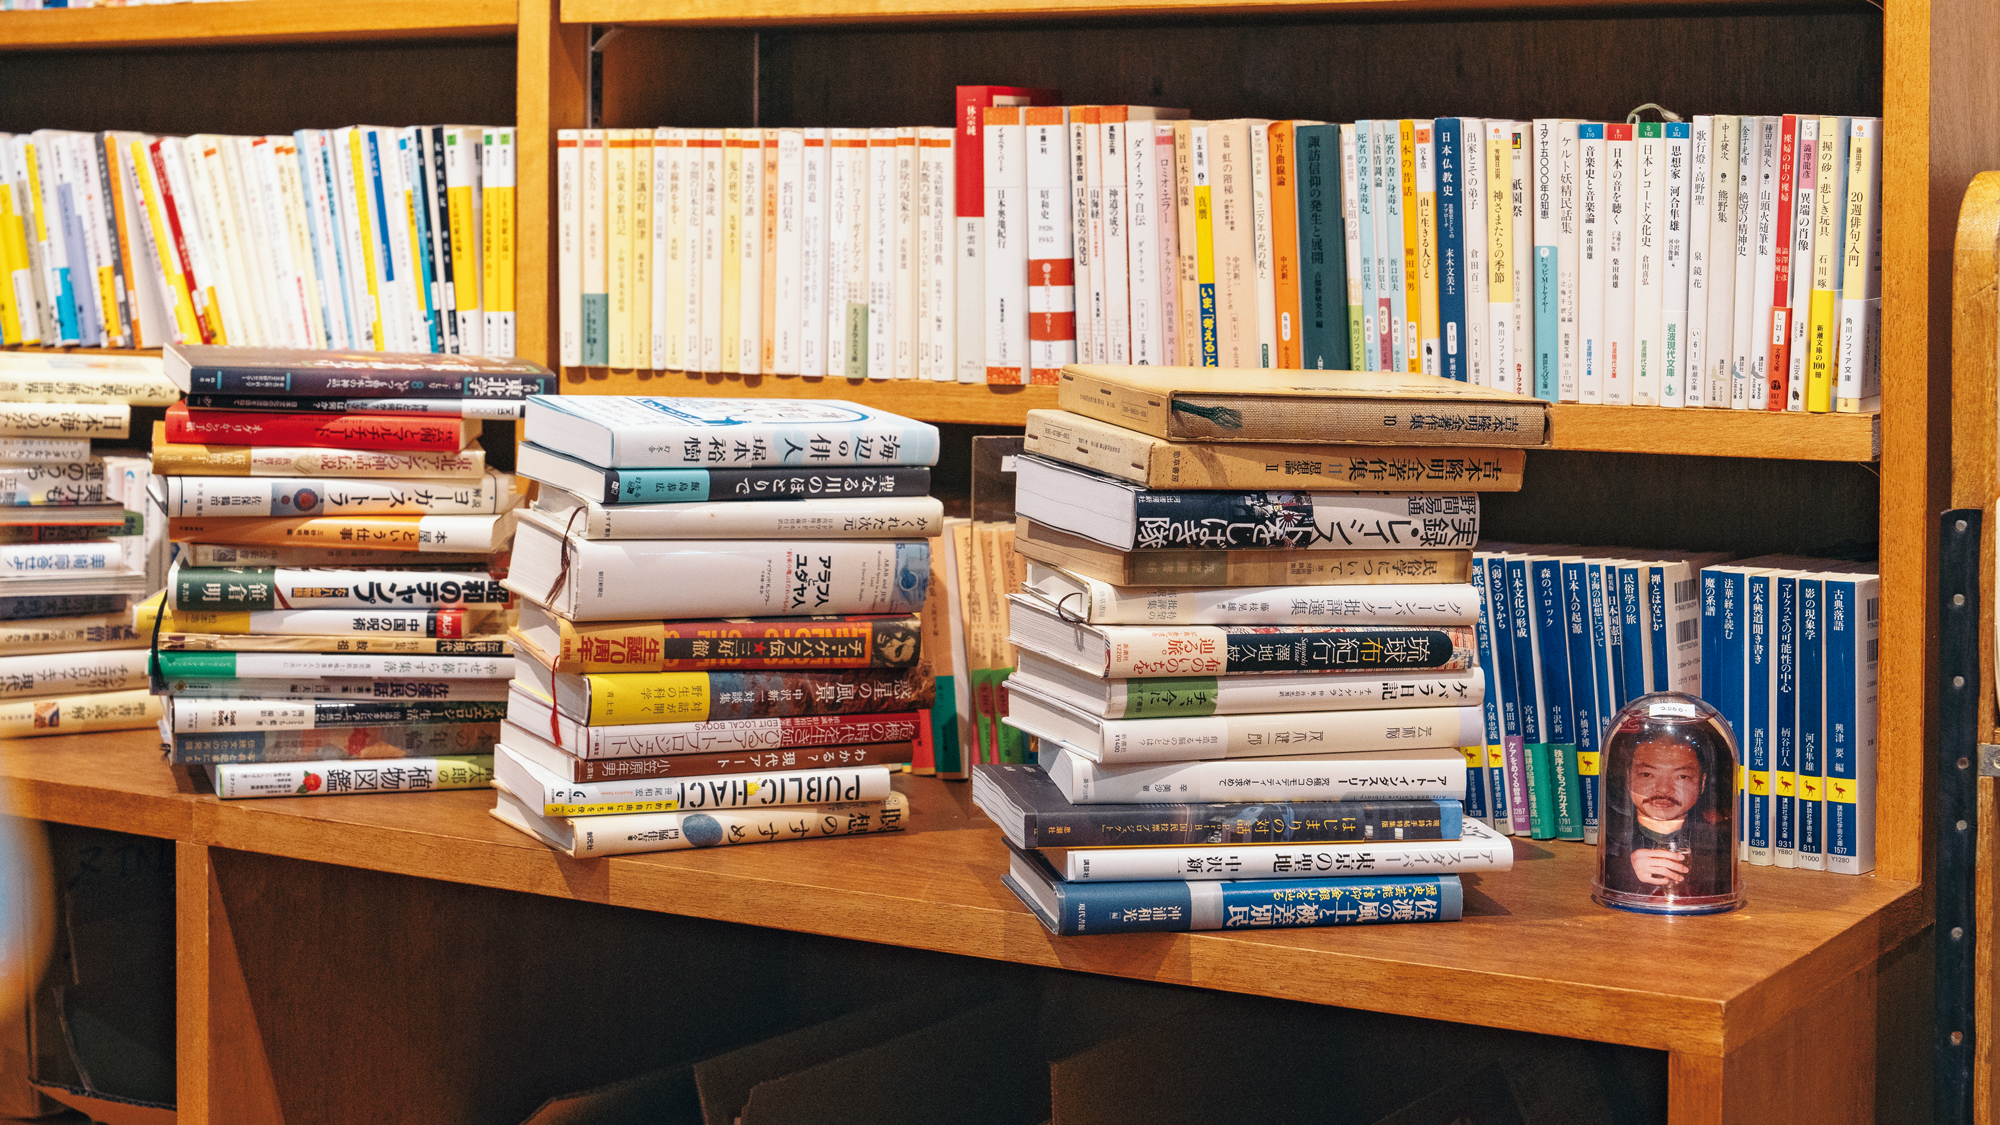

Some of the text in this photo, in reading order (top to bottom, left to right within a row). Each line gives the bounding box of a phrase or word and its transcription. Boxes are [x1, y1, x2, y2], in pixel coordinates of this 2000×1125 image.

[1196, 136, 1204, 166] 吉本隆明
[1720, 123, 1730, 161] 中上健次
[1741, 125, 1750, 166] 金子光晴
[1763, 124, 1773, 168] 種田山頭火
[1178, 134, 1189, 207] 対話 日本の原像
[1221, 153, 1233, 200] 虹の階梯
[1275, 133, 1286, 187] 雪片曲線論
[1357, 133, 1370, 215] 死者の書・身毒丸
[1385, 133, 1398, 216] 死者の書・身毒丸
[1401, 131, 1413, 197] 日本の昔話
[1419, 147, 1427, 173] 宮本常一
[1442, 131, 1453, 197] 日本仏教史
[1467, 131, 1479, 210] 出家とその弟子
[1694, 130, 1706, 206] 歌行燈・高野聖
[1780, 133, 1792, 202] 裸婦の中の裸婦
[729, 161, 739, 203] 鬼の研究
[808, 160, 817, 203] 仮面の道
[900, 159, 910, 224] 排除の現象学
[1134, 138, 1145, 226] ダライ・ラマ自伝
[1160, 158, 1171, 224] ロミオ・エラー
[1560, 136, 1572, 234] ケルト妖精民話集
[1611, 147, 1623, 225] 日本の音を聴く
[1641, 144, 1652, 247] 日本レコード文化史
[1669, 145, 1682, 232] 思想家 河合隼雄
[1819, 133, 1833, 237] 一握の砂・悲しき玩具
[783, 181, 793, 233] 折口信夫
[933, 161, 943, 266] 英語類義語活用辞典
[1040, 190, 1050, 220] 昭和史
[1109, 189, 1119, 237] 神道の成立
[1308, 134, 1324, 264] 諏訪信仰の発生と展開
[1584, 145, 1596, 261] 音楽史と音楽論 柴田南雄
[1717, 189, 1728, 223] 熊野集
[998, 190, 1007, 249] 日本奥地紀行
[1076, 188, 1088, 266] 日本音楽の再発見
[1347, 198, 1358, 240] 先祖の話
[1737, 191, 1749, 257] 絶望の精神史
[1758, 190, 1771, 256] 山頭火随筆集
[1797, 192, 1811, 252] 異端の肖像
[967, 222, 976, 258] 狂雲集
[1256, 203, 1267, 280] 三万年の死の教え
[1420, 197, 1431, 279] 山に生きる人びと
[1493, 190, 1505, 284] 神さまたちの季節
[1363, 257, 1372, 291] 折口信夫
[1390, 258, 1399, 292] 折口信夫
[1405, 248, 1415, 292] 柳田国男
[1446, 248, 1455, 295] 末木文美士
[1471, 248, 1480, 293] 倉田百三
[1692, 251, 1702, 288] 泉鏡花
[1666, 323, 1676, 378] 岩波現代文庫
[1812, 324, 1825, 379] 新潮文庫の100冊
[1843, 317, 1853, 382] 角川ソフィア文庫
[468, 377, 523, 396] 東北学
[185, 421, 452, 442] 芸術とマルチチュード ネグリからの手紙
[1410, 413, 1518, 432] 吉本隆明全著作集
[320, 454, 472, 471] 東北アジアの神話・伝説
[683, 433, 901, 464] 海辺の俳人 堀本裕樹
[28, 462, 104, 482] 運のうち
[736, 475, 895, 495] 聖なる川のほとりで
[1285, 456, 1502, 482] 吉本隆明全著作集 11 思想論
[46, 483, 104, 502] 実力も
[210, 496, 262, 506] 佐保田鶴治
[328, 490, 470, 508] ヨーガ・スートラ
[472, 488, 482, 508] 解説
[655, 481, 700, 493] 飯島恭広
[1408, 495, 1476, 517] 野間易通
[339, 528, 448, 544] 本屋という仕事
[843, 516, 928, 532] かくれた次元
[1138, 516, 1477, 549] 実録・レイシストをしばき隊
[791, 554, 808, 610] ユダヤ人
[807, 578, 819, 587] と
[814, 555, 832, 609] アラブ人
[1330, 558, 1437, 577] 民俗学について
[199, 582, 223, 602] 明
[227, 582, 267, 603] 笹倉
[1148, 599, 1178, 609] 批評集
[1227, 598, 1463, 616] グリーンバーグ批評選集 藤枝晃雄
[1512, 568, 1528, 638] 日本文化の形成
[1540, 568, 1554, 628] 森のバロック
[1568, 569, 1583, 635] 日本人の起源
[1590, 570, 1604, 647] 空海の思想について
[1624, 573, 1637, 625] 民俗学の旅
[1650, 573, 1663, 632] 禅とはなにか
[1704, 577, 1716, 617] 魔の系譜
[1724, 578, 1735, 640] 法華経を読む
[352, 618, 420, 632] 中国の呪術
[1148, 611, 1178, 620] 待望の
[1752, 582, 1764, 666] 沢木興道聞き書き
[1804, 587, 1816, 641] 影の現象学
[1833, 589, 1845, 632] 古典落語
[337, 640, 368, 651] 教祖
[440, 640, 500, 653] 伝統と現代
[577, 635, 660, 664] 生誕70周年
[769, 639, 863, 658] チェ・ゲバラ伝
[1312, 636, 1430, 665] 琉球布紀行
[1779, 583, 1792, 693] マルクスその可能性の中心
[383, 661, 498, 675] 幸せに暮らす集落
[1132, 657, 1221, 675] 布のいのちを
[374, 682, 449, 699] 佐渡の民話
[640, 685, 702, 700] 野生の科学
[760, 688, 803, 702] 中沢新一
[814, 679, 912, 703] 惑星の風景
[1329, 687, 1372, 697] チェ・ゲバラ
[1381, 680, 1468, 701] ゲバラ日記
[640, 701, 702, 715] 対話が開く
[726, 721, 757, 729] LOCAL
[1485, 702, 1498, 741] 今泉忠義
[694, 723, 726, 731] BOOKS
[1835, 723, 1845, 743] 興津
[717, 752, 796, 768] 現代アート
[1780, 726, 1792, 768] 柄谷行人
[1804, 732, 1815, 772] 河合隼雄
[326, 767, 433, 793] 植物図鑑
[601, 759, 671, 777] 小笠原年男
[1337, 776, 1446, 787] アート・インダストリー
[1508, 741, 1522, 805] ケアをめぐる哲学
[1553, 748, 1569, 818] 秩序をもったカオス
[760, 775, 860, 805] PUBLIC
[728, 808, 901, 843] 瞑想のすすめ
[1236, 817, 1356, 835] はじまりの対話
[1381, 819, 1439, 829] 現代詩手帖特集版
[1385, 849, 1494, 869] アースダイバー
[1750, 838, 1766, 847] 639
[1777, 848, 1793, 856] Y880
[1778, 839, 1792, 848] 931
[1800, 855, 1820, 863] Y1000
[1802, 844, 1817, 853] 811
[1833, 846, 1848, 855] 1577
[1176, 852, 1375, 874] 東京の聖地 中沢新一
[1830, 856, 1850, 865] Y1280
[1123, 905, 1182, 923] 沖浦和光
[1225, 897, 1437, 927] 佐渡の風土と被差別民
